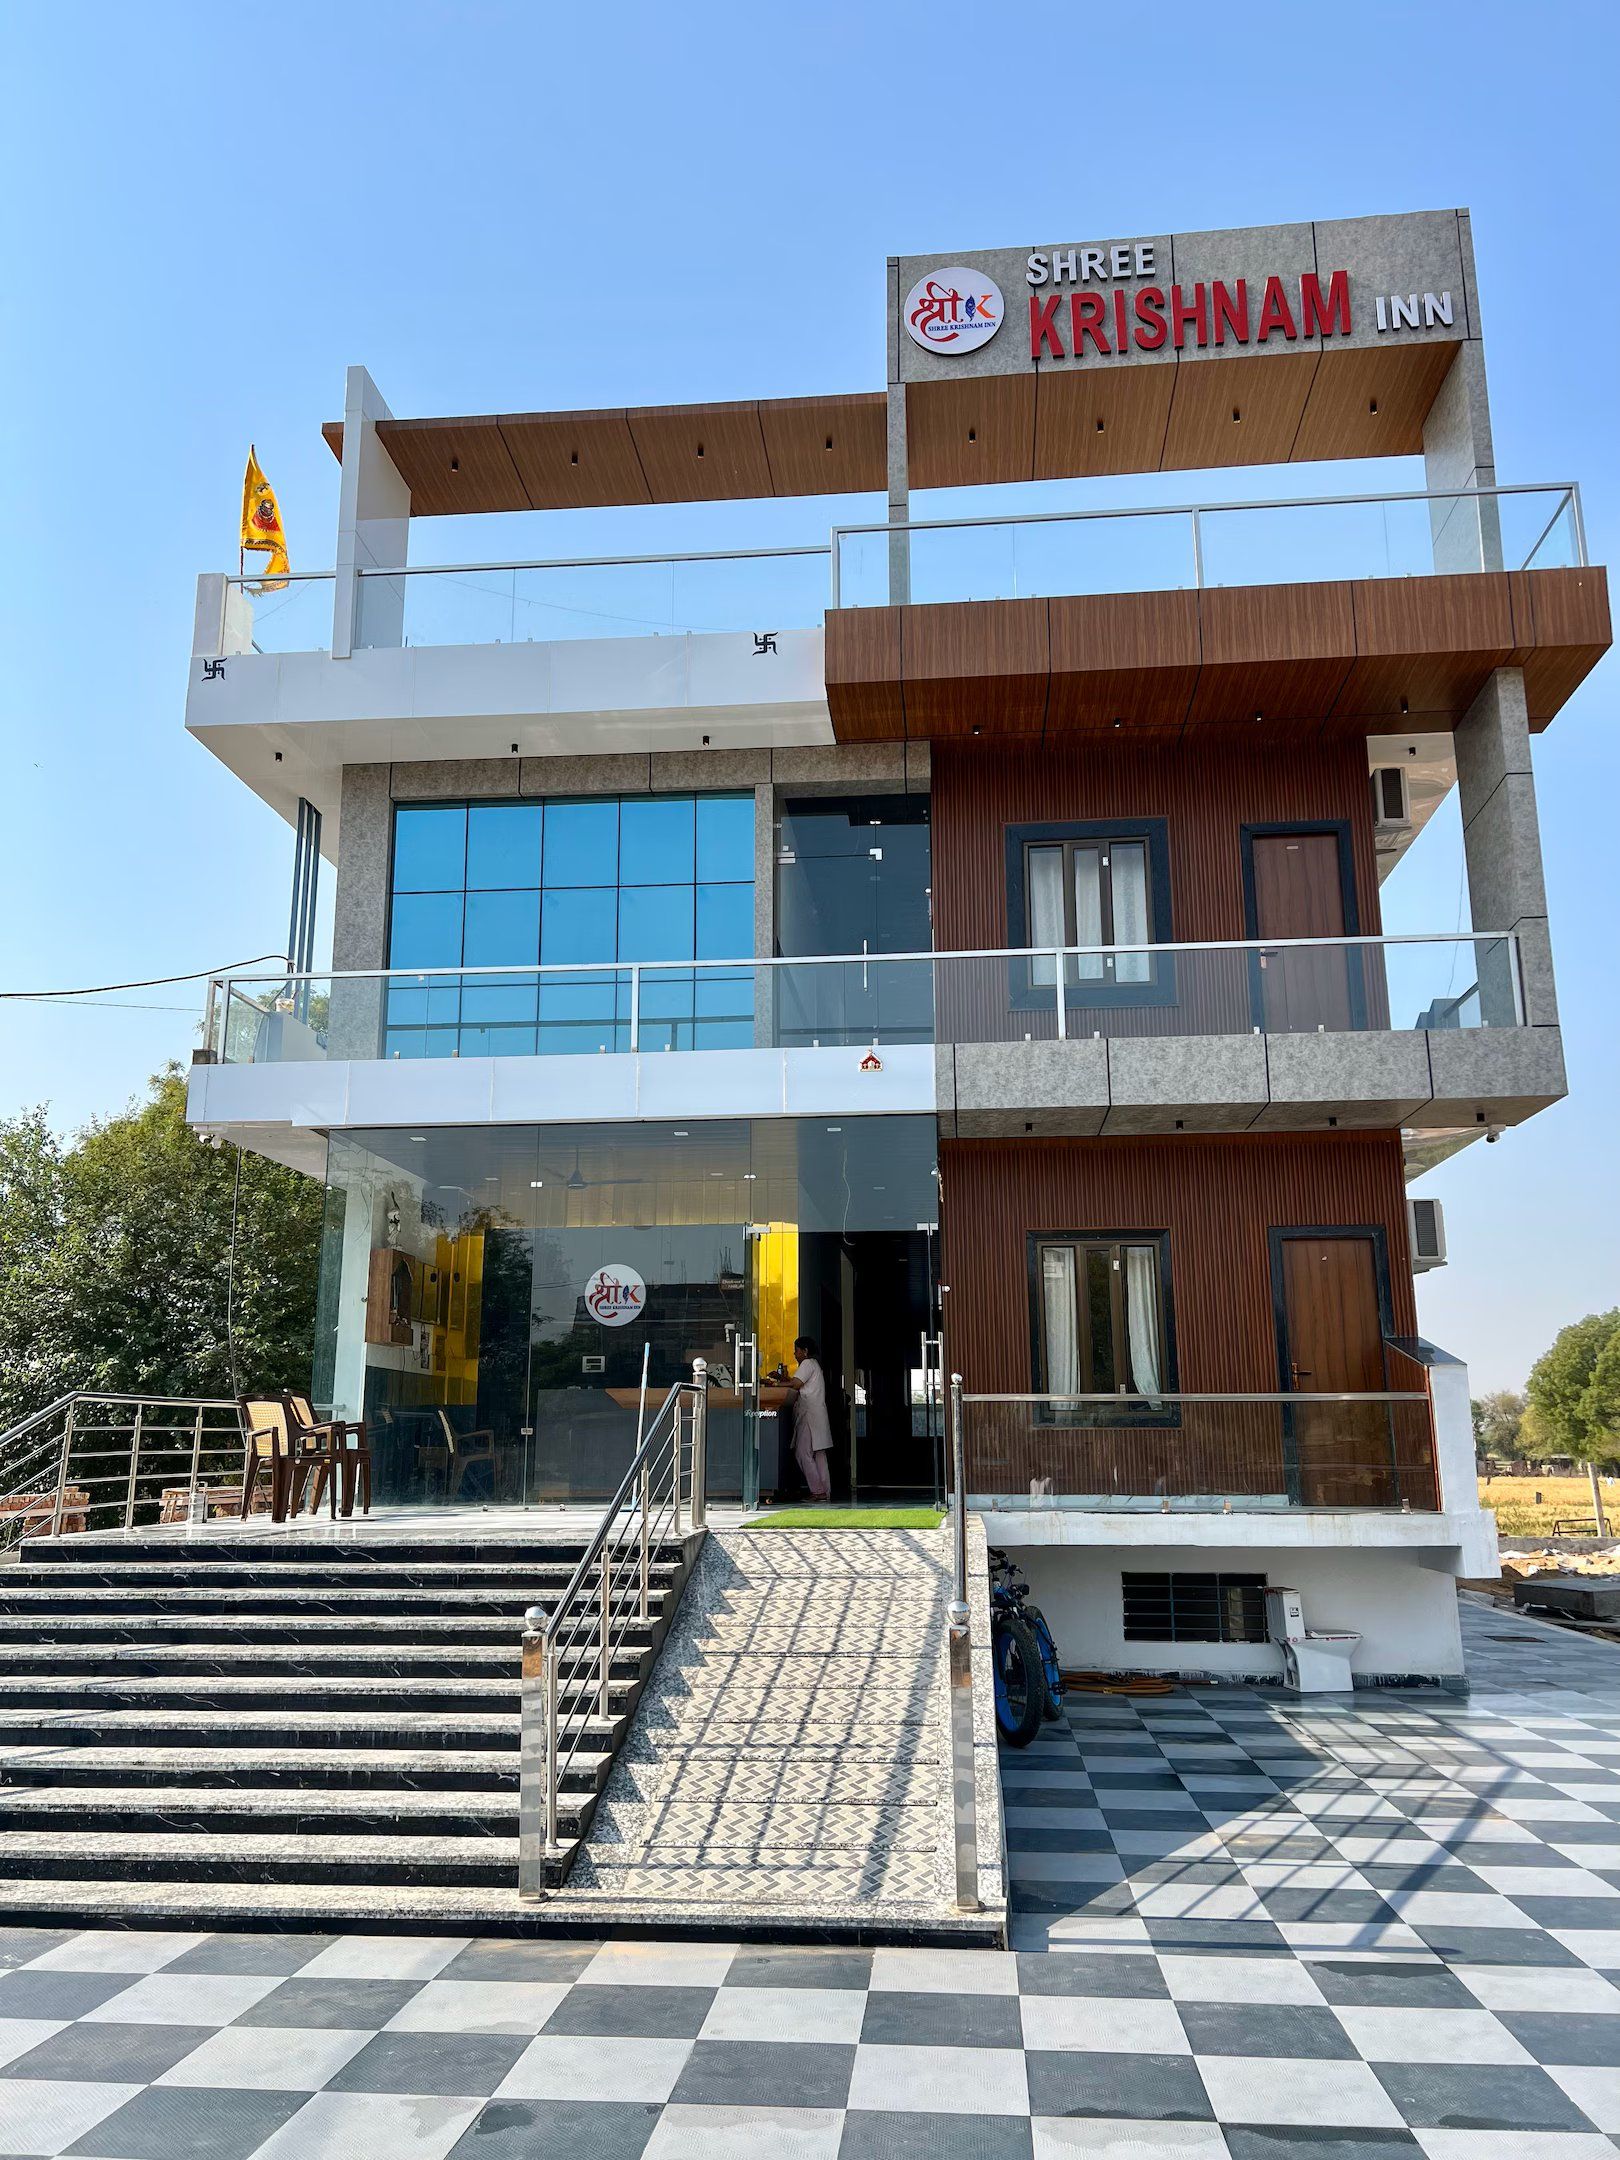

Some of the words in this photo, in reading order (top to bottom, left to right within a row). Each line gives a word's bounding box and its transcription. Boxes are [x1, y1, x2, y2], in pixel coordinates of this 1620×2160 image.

[1025, 242, 1156, 287] SHREE
[1028, 270, 1352, 361] KRISHNAM
[1375, 291, 1454, 333] INN
